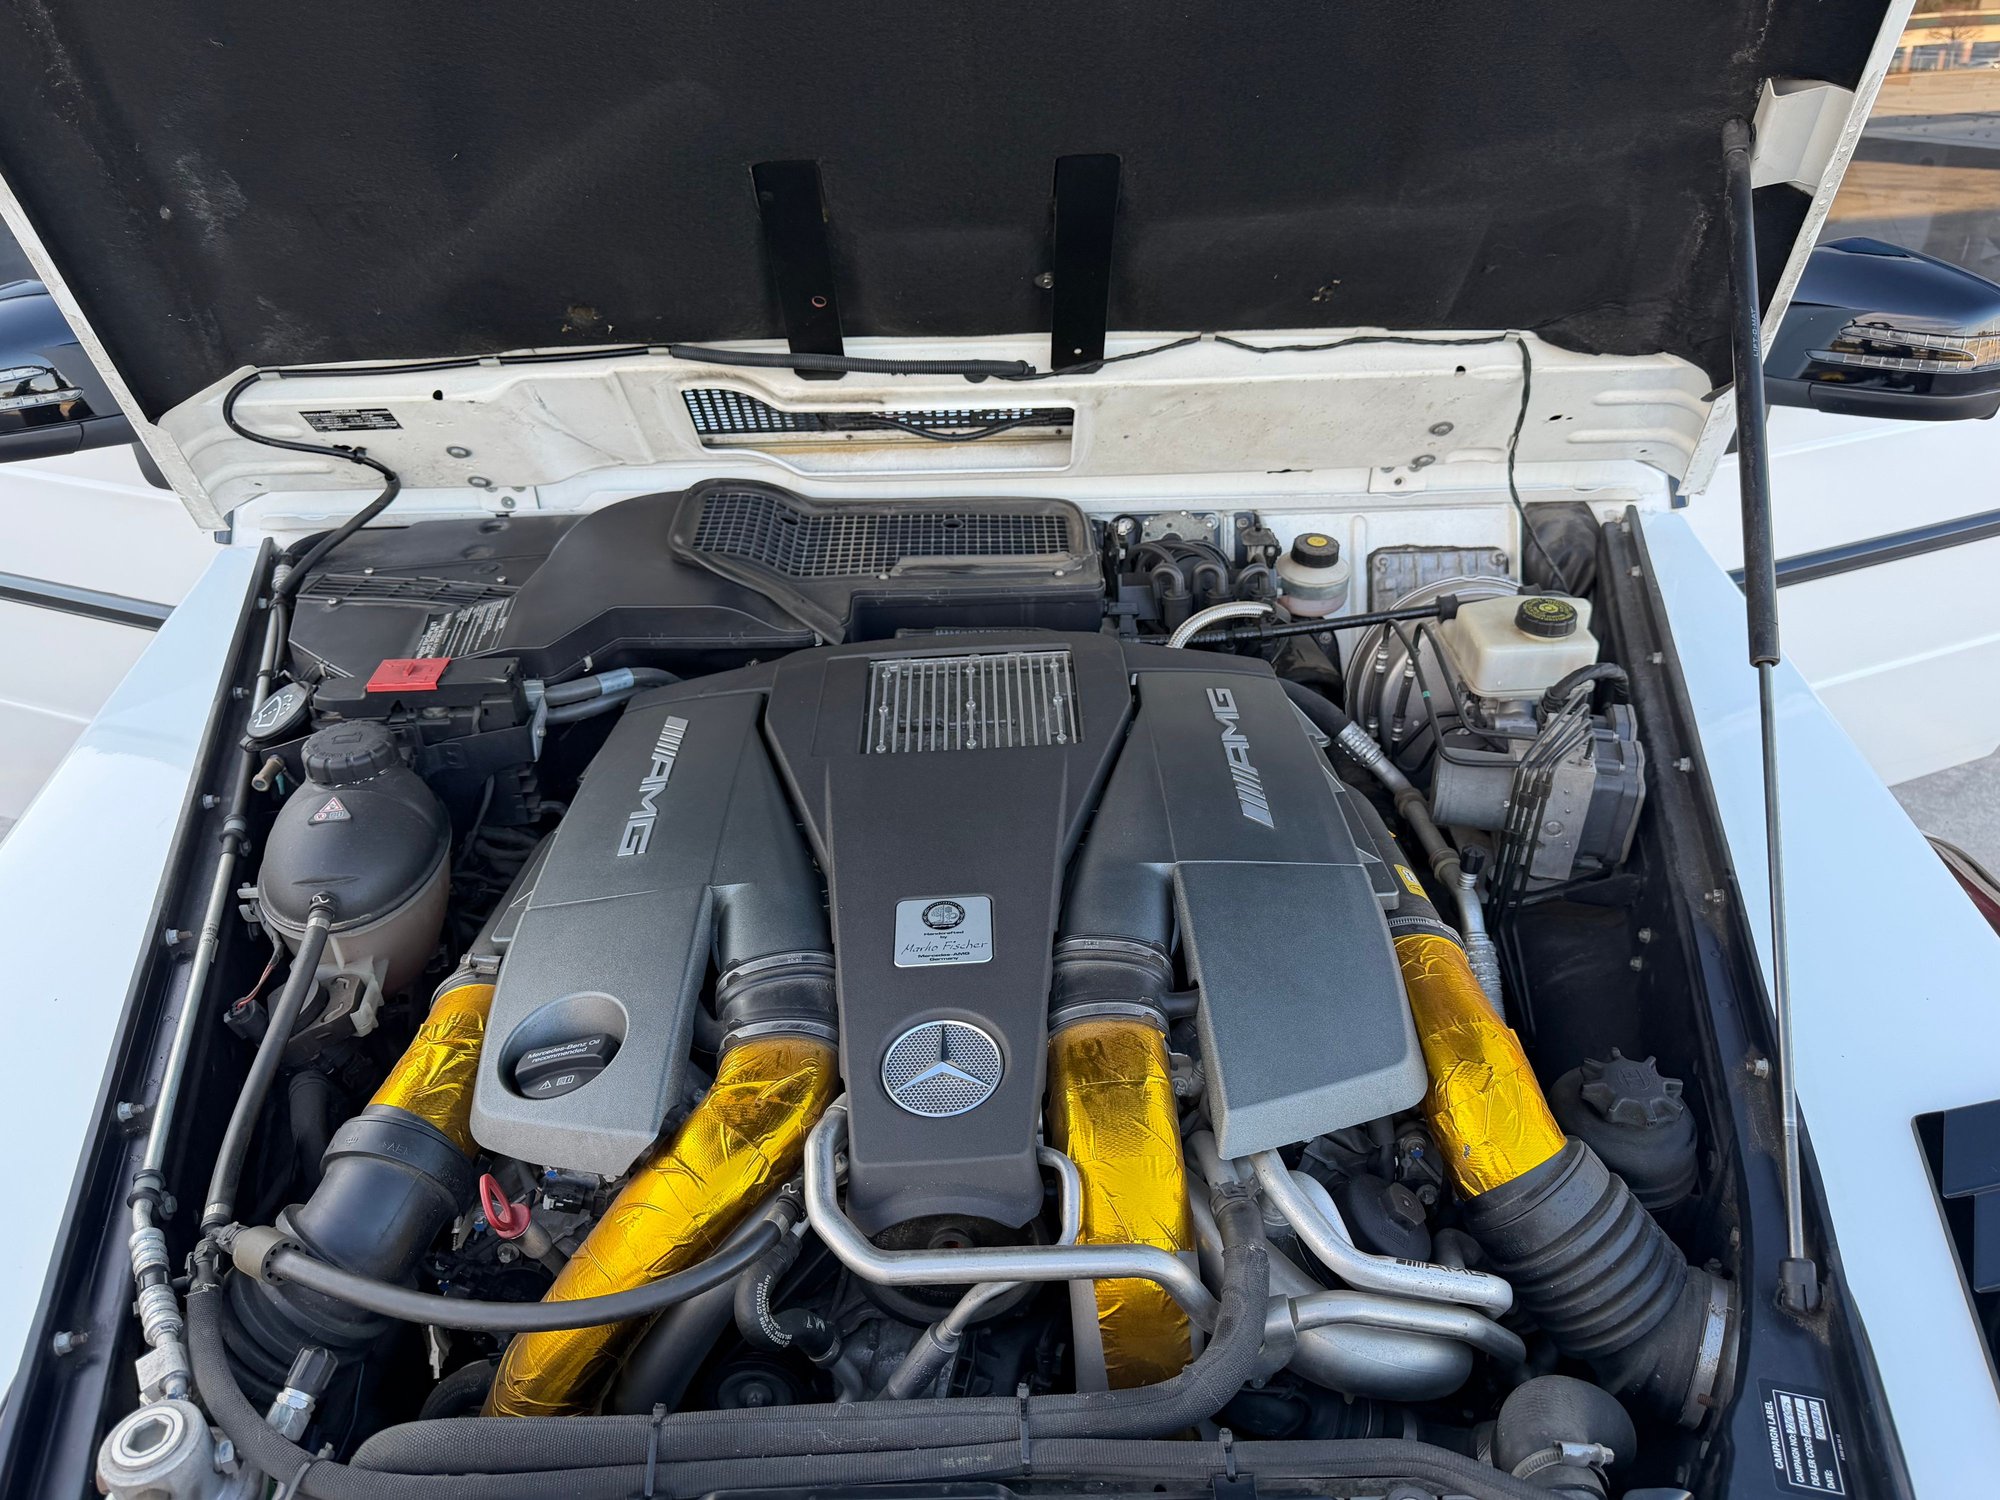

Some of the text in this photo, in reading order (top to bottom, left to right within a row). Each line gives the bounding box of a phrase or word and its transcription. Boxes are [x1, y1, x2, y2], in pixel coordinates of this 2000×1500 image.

[1206, 688, 1259, 777] AMG
[617, 751, 675, 857] AMG
[917, 951, 971, 959] Mercedes-AMG
[942, 939, 988, 951] Fischer
[527, 1041, 588, 1060] Mercedes-Benz
[531, 1046, 588, 1063] recommended
[1764, 1400, 1784, 1470] CAMPAIGN LABEL
[1789, 1434, 1798, 1446] NO:
[1803, 1437, 1815, 1458] CODE:
[1791, 1446, 1805, 1483] CAMPAIGN
[1807, 1459, 1821, 1486] DEALER
[1824, 1470, 1836, 1489] DATE:
